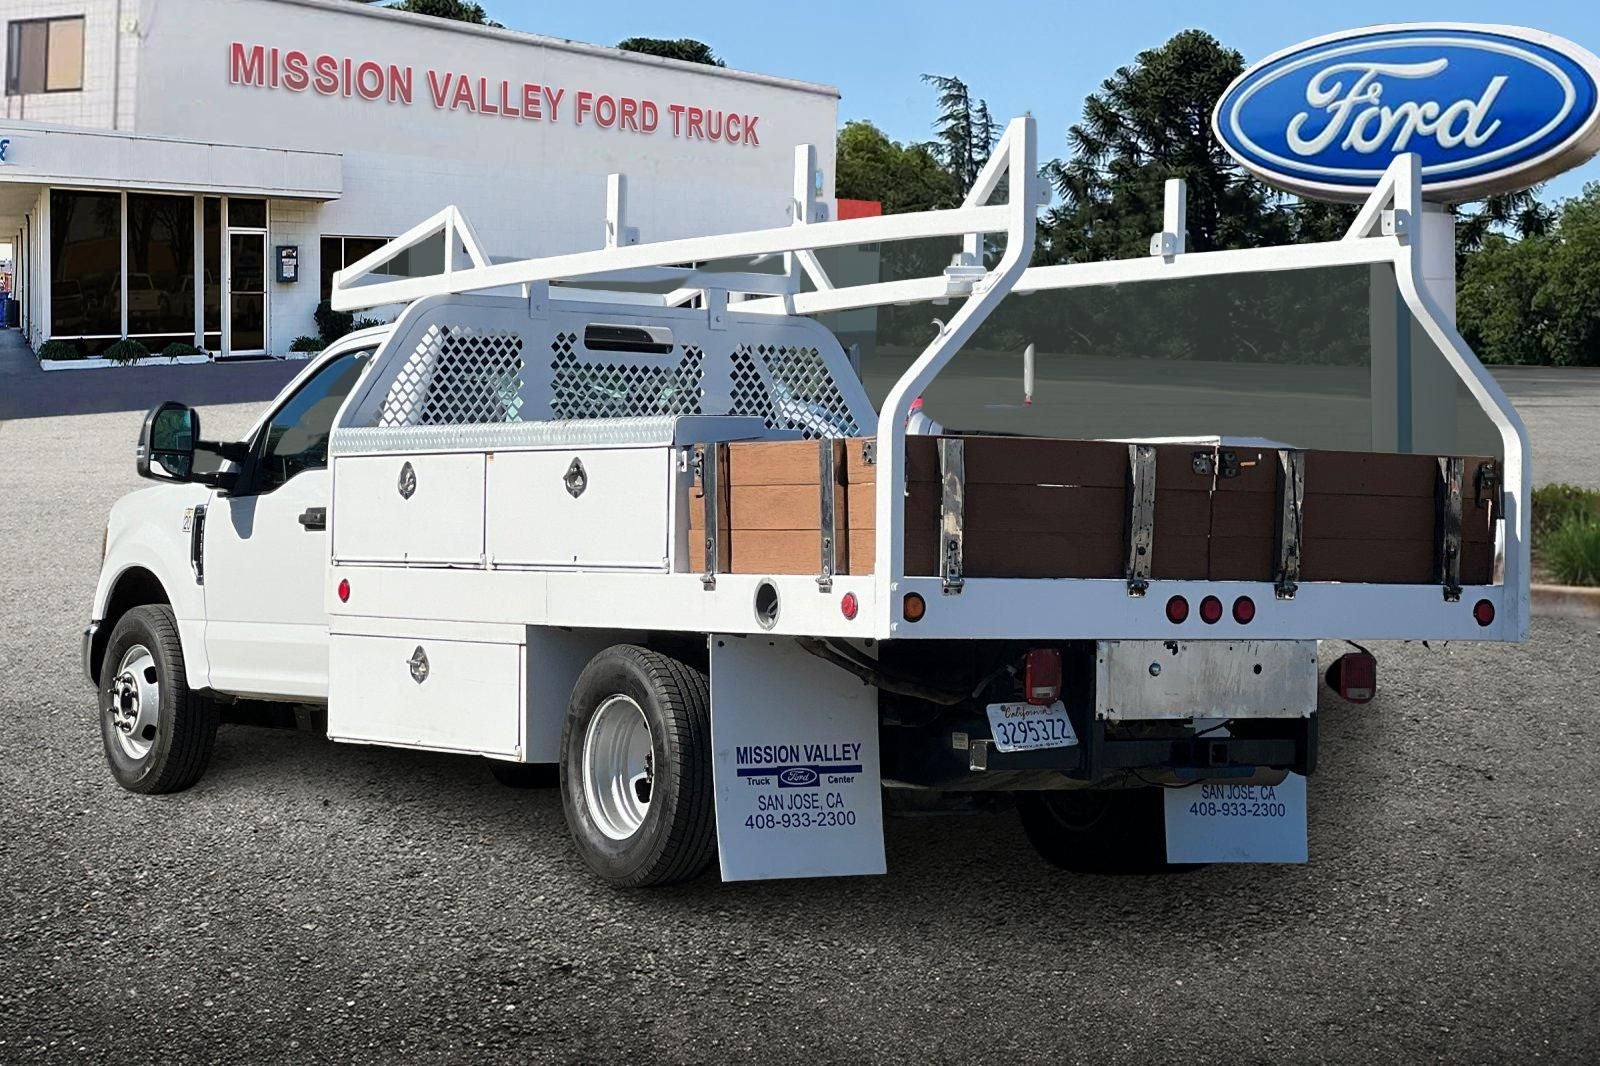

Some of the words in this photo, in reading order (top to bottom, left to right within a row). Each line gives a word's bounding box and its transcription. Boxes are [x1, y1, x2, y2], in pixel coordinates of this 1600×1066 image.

[229, 41, 413, 105] MISSION
[427, 69, 565, 122] VALLEY
[575, 90, 659, 134] FORD
[669, 103, 761, 146] TRUCK
[1286, 58, 1509, 156] Ford
[1004, 706, 1052, 721] California
[997, 718, 1071, 745] 32953Z2
[736, 745, 800, 764] MISSION
[804, 743, 861, 762] VALLEY
[747, 777, 770, 786] Truck
[787, 770, 810, 782] Ford
[827, 775, 855, 784] Center
[758, 794, 784, 811] SAN
[787, 792, 823, 811] JOSE,
[826, 792, 844, 809] CA
[1201, 784, 1225, 800] SAN
[1227, 784, 1258, 802] JOSE,
[1260, 785, 1276, 800] CA
[1189, 802, 1286, 817] 408-933-2300
[745, 810, 856, 830] 408-933-2300
